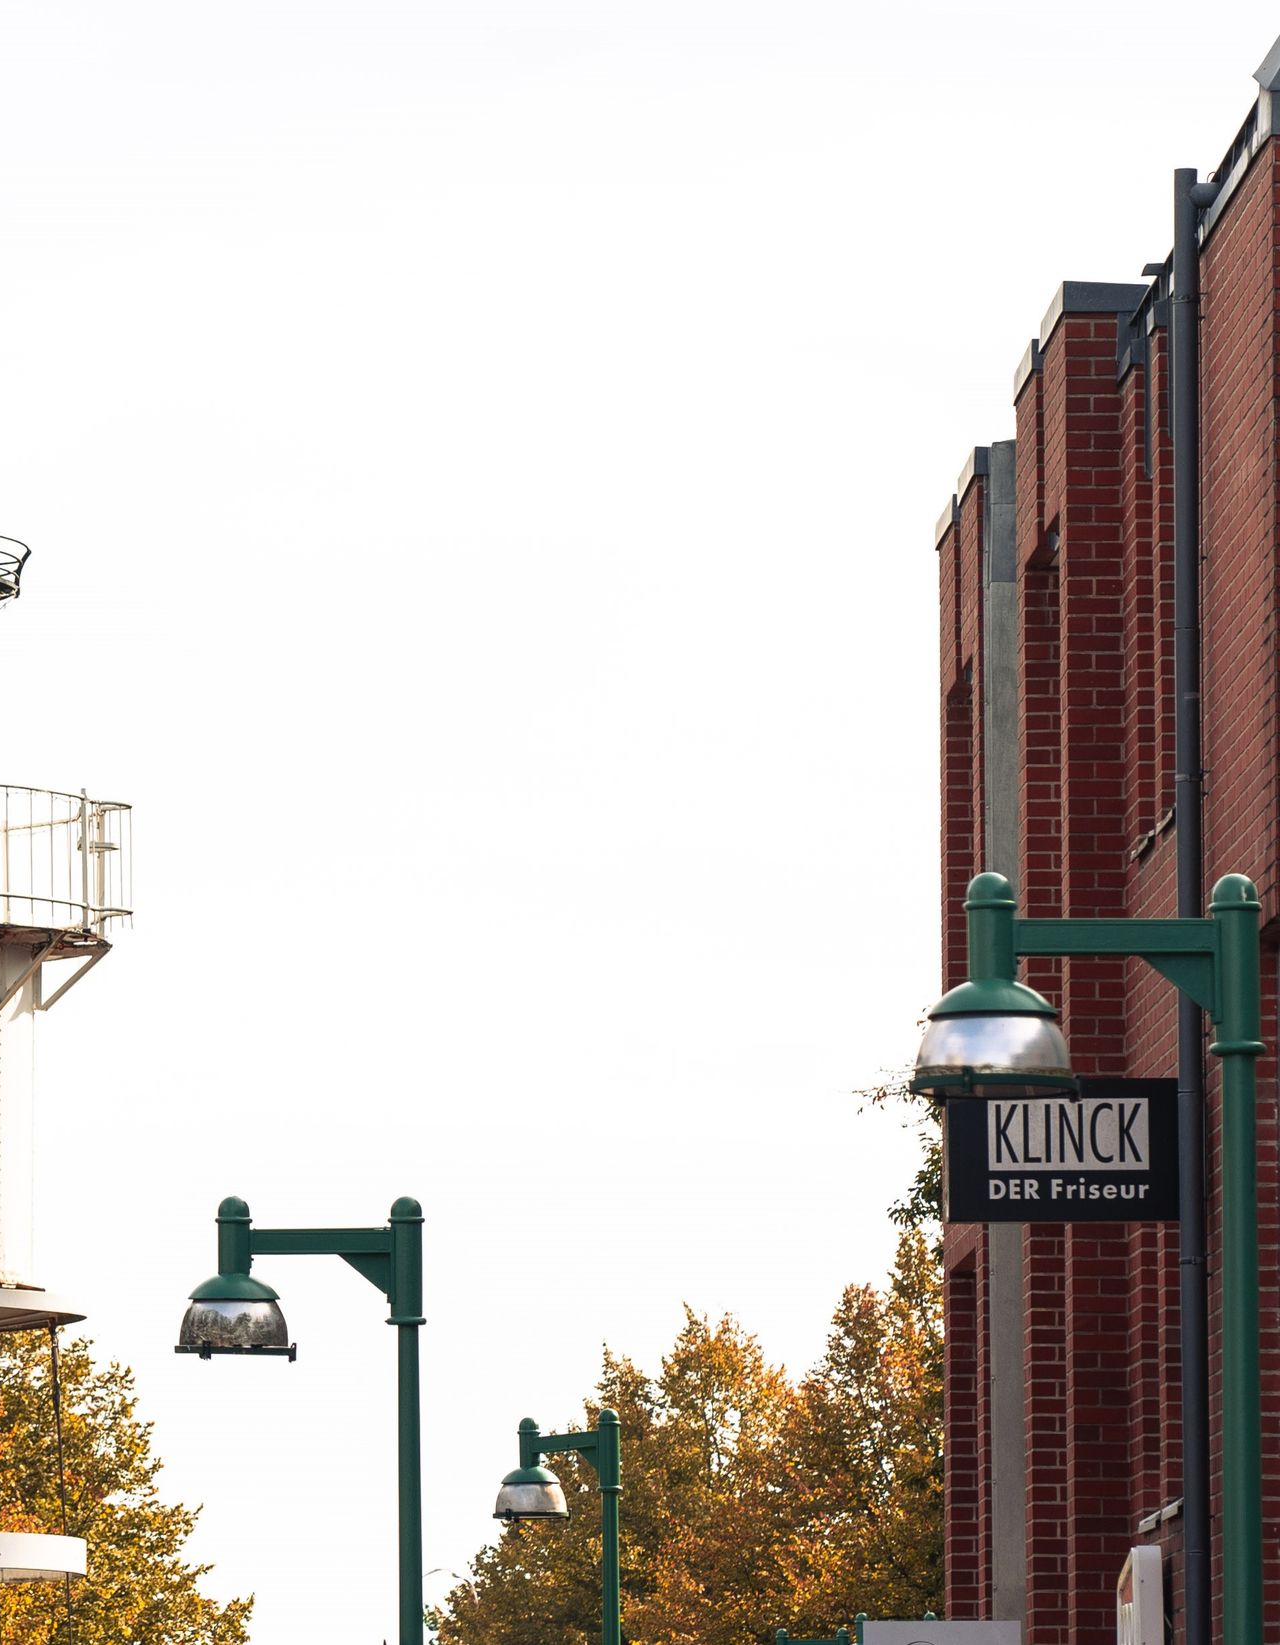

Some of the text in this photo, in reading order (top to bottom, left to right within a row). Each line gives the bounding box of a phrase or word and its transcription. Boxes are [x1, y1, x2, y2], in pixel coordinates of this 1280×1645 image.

[995, 1102, 1142, 1164] KLINCK
[989, 1177, 1150, 1200] DER Friseur
